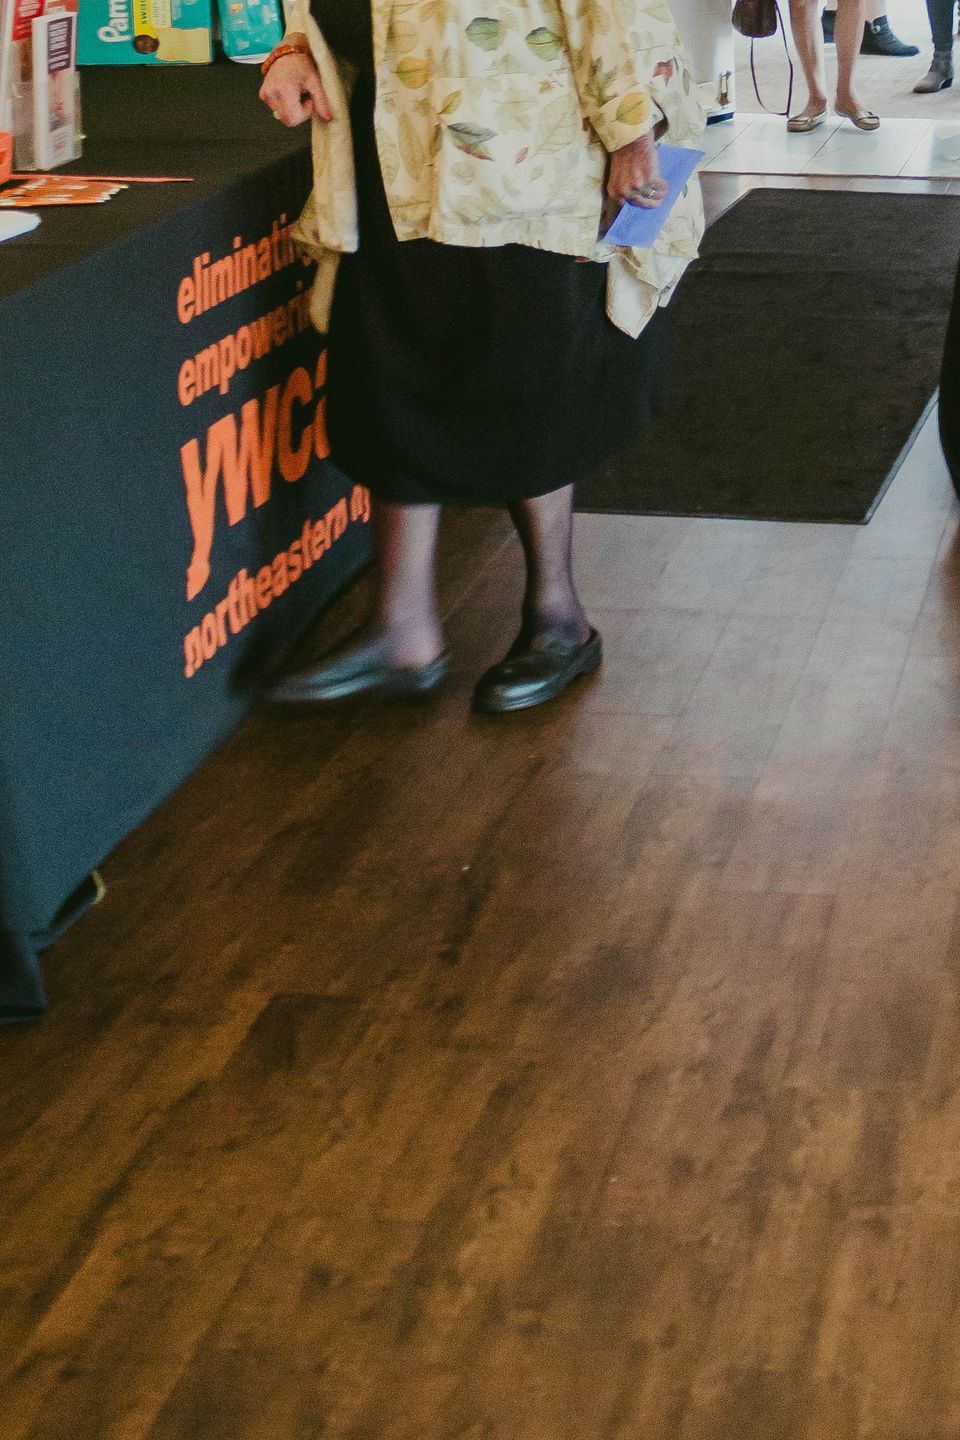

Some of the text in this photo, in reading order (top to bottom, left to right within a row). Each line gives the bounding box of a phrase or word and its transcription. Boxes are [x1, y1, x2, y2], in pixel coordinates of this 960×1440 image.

[177, 213, 312, 324] eliminati
[177, 281, 311, 407] empoweri
[183, 497, 348, 679] northeastern
